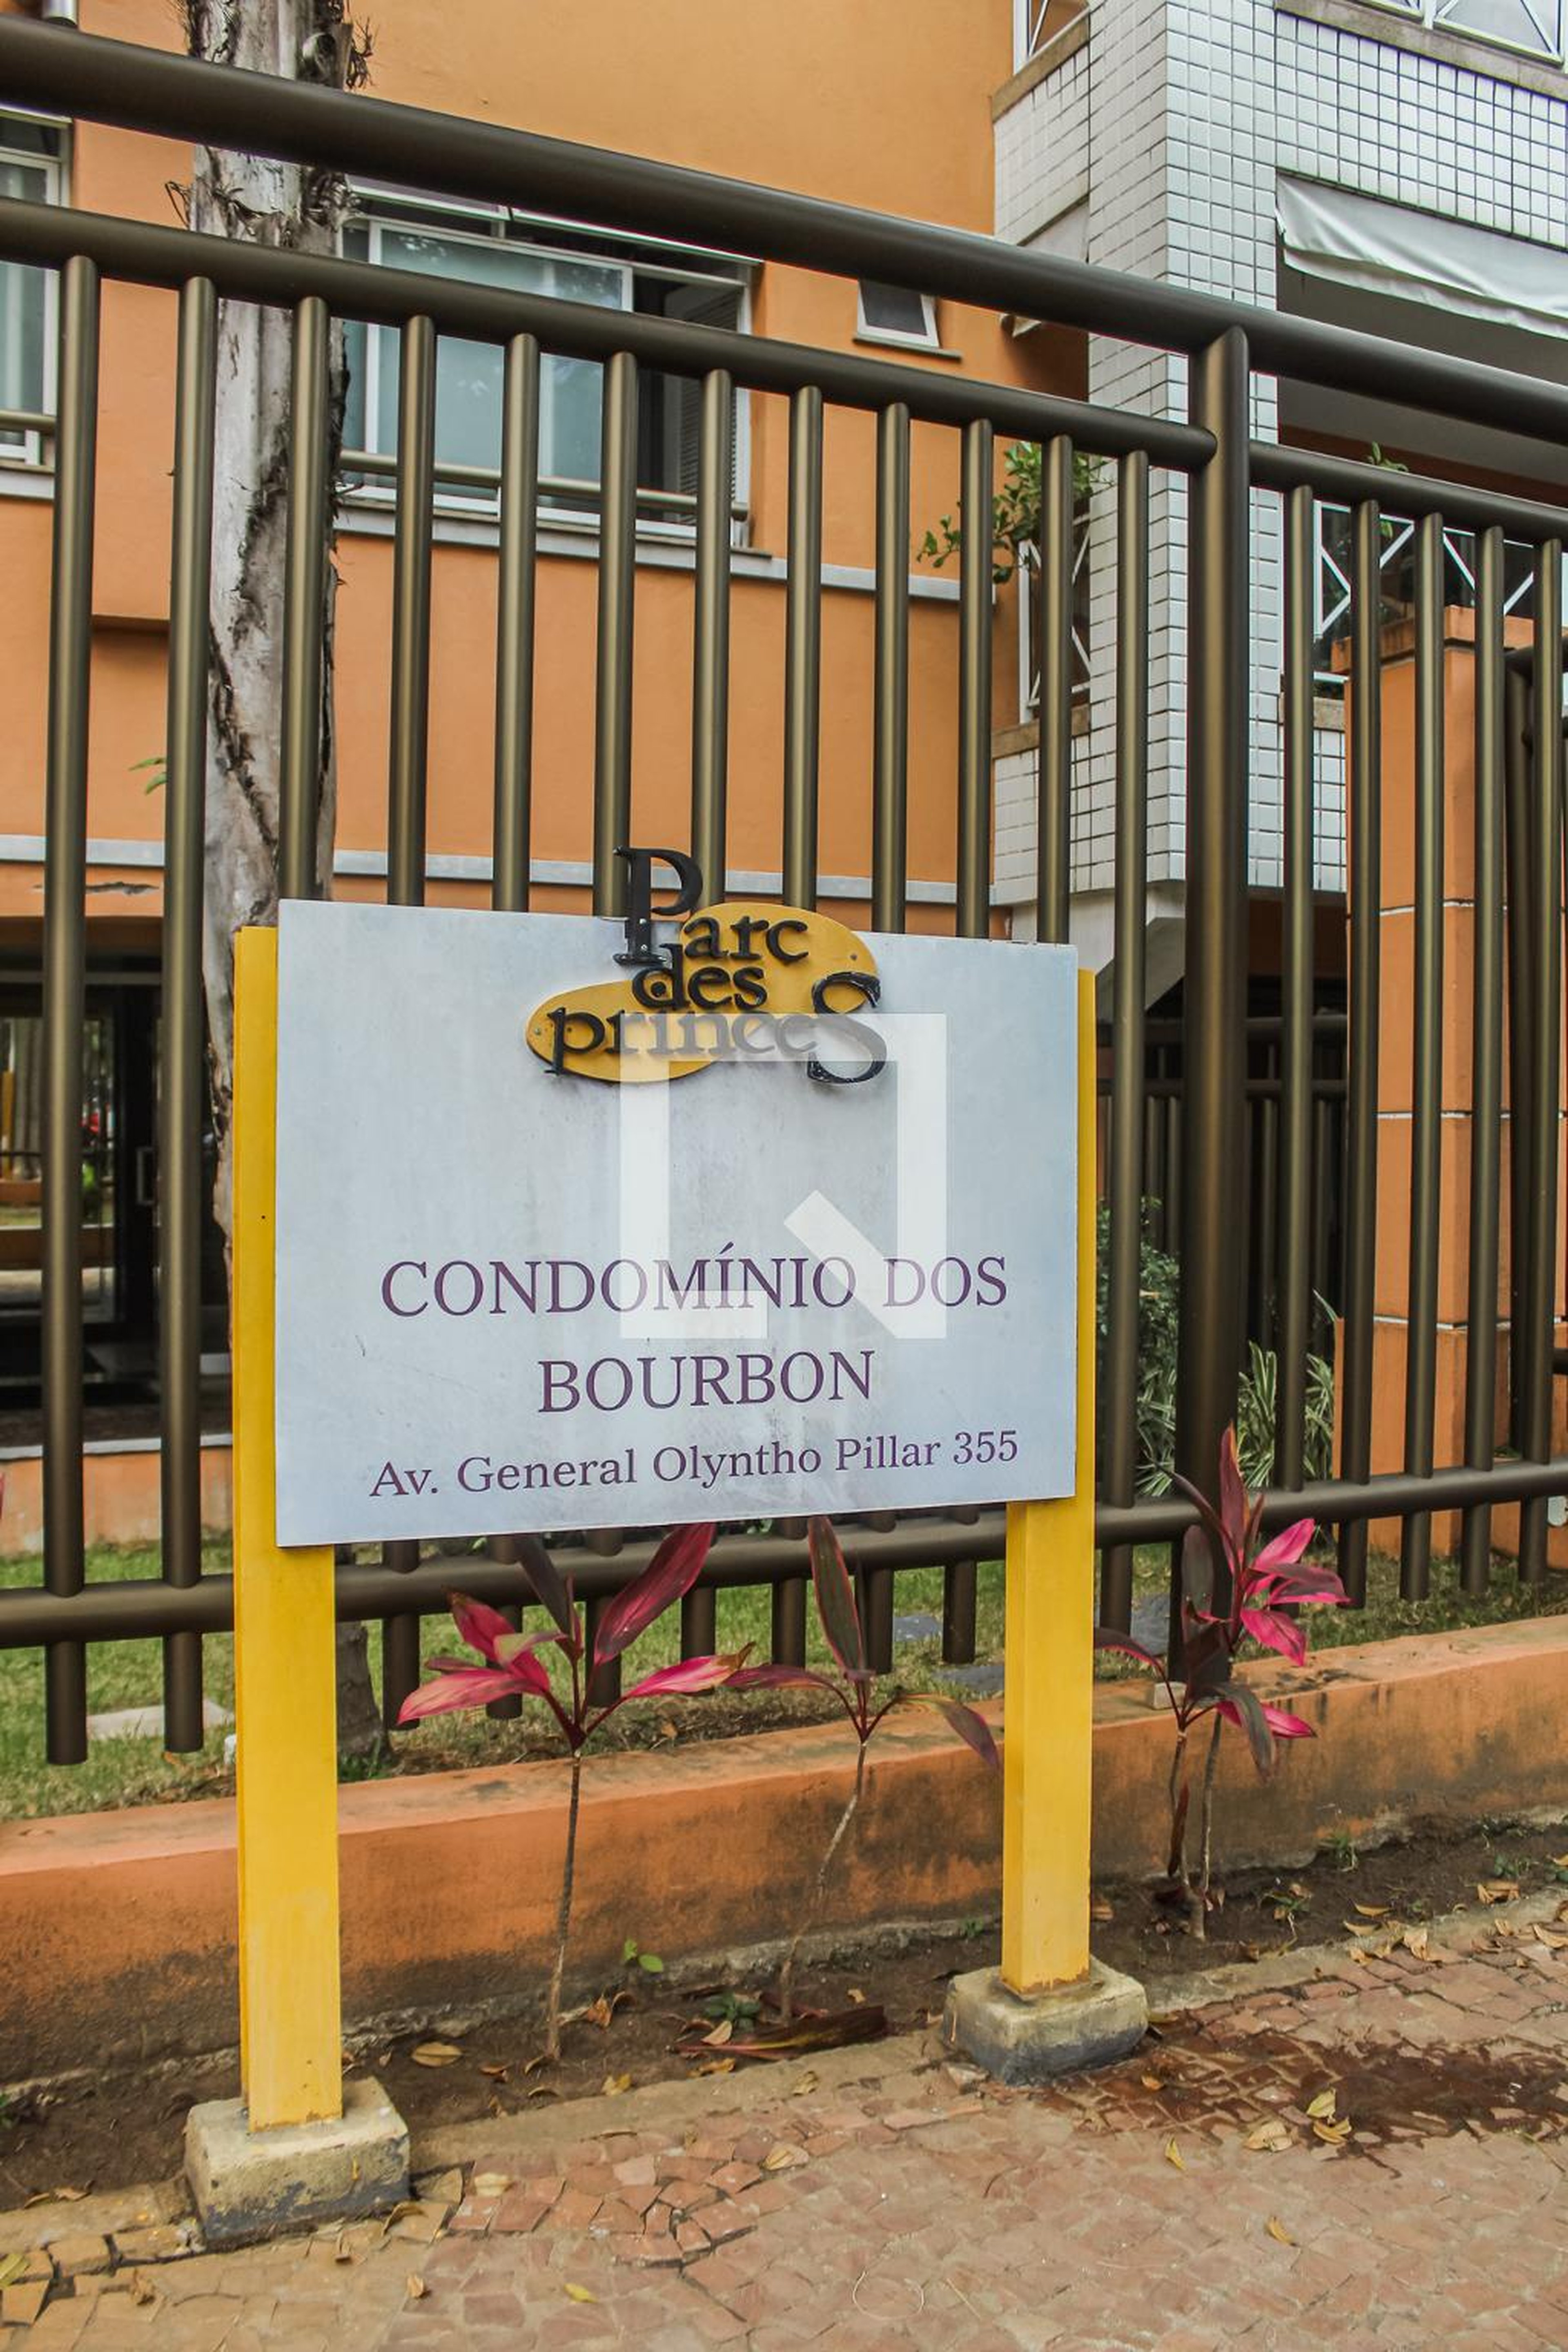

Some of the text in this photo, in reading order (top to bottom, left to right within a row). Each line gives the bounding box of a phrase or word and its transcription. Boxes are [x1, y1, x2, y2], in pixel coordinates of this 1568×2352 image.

[612, 845, 809, 966] Parc
[632, 942, 768, 1011] des
[381, 1243, 1007, 1317] CONDOMÍNIO DOS
[538, 1350, 875, 1413] BOURBON
[369, 1430, 1018, 1497] Av. General Olyntho Pillar 355
